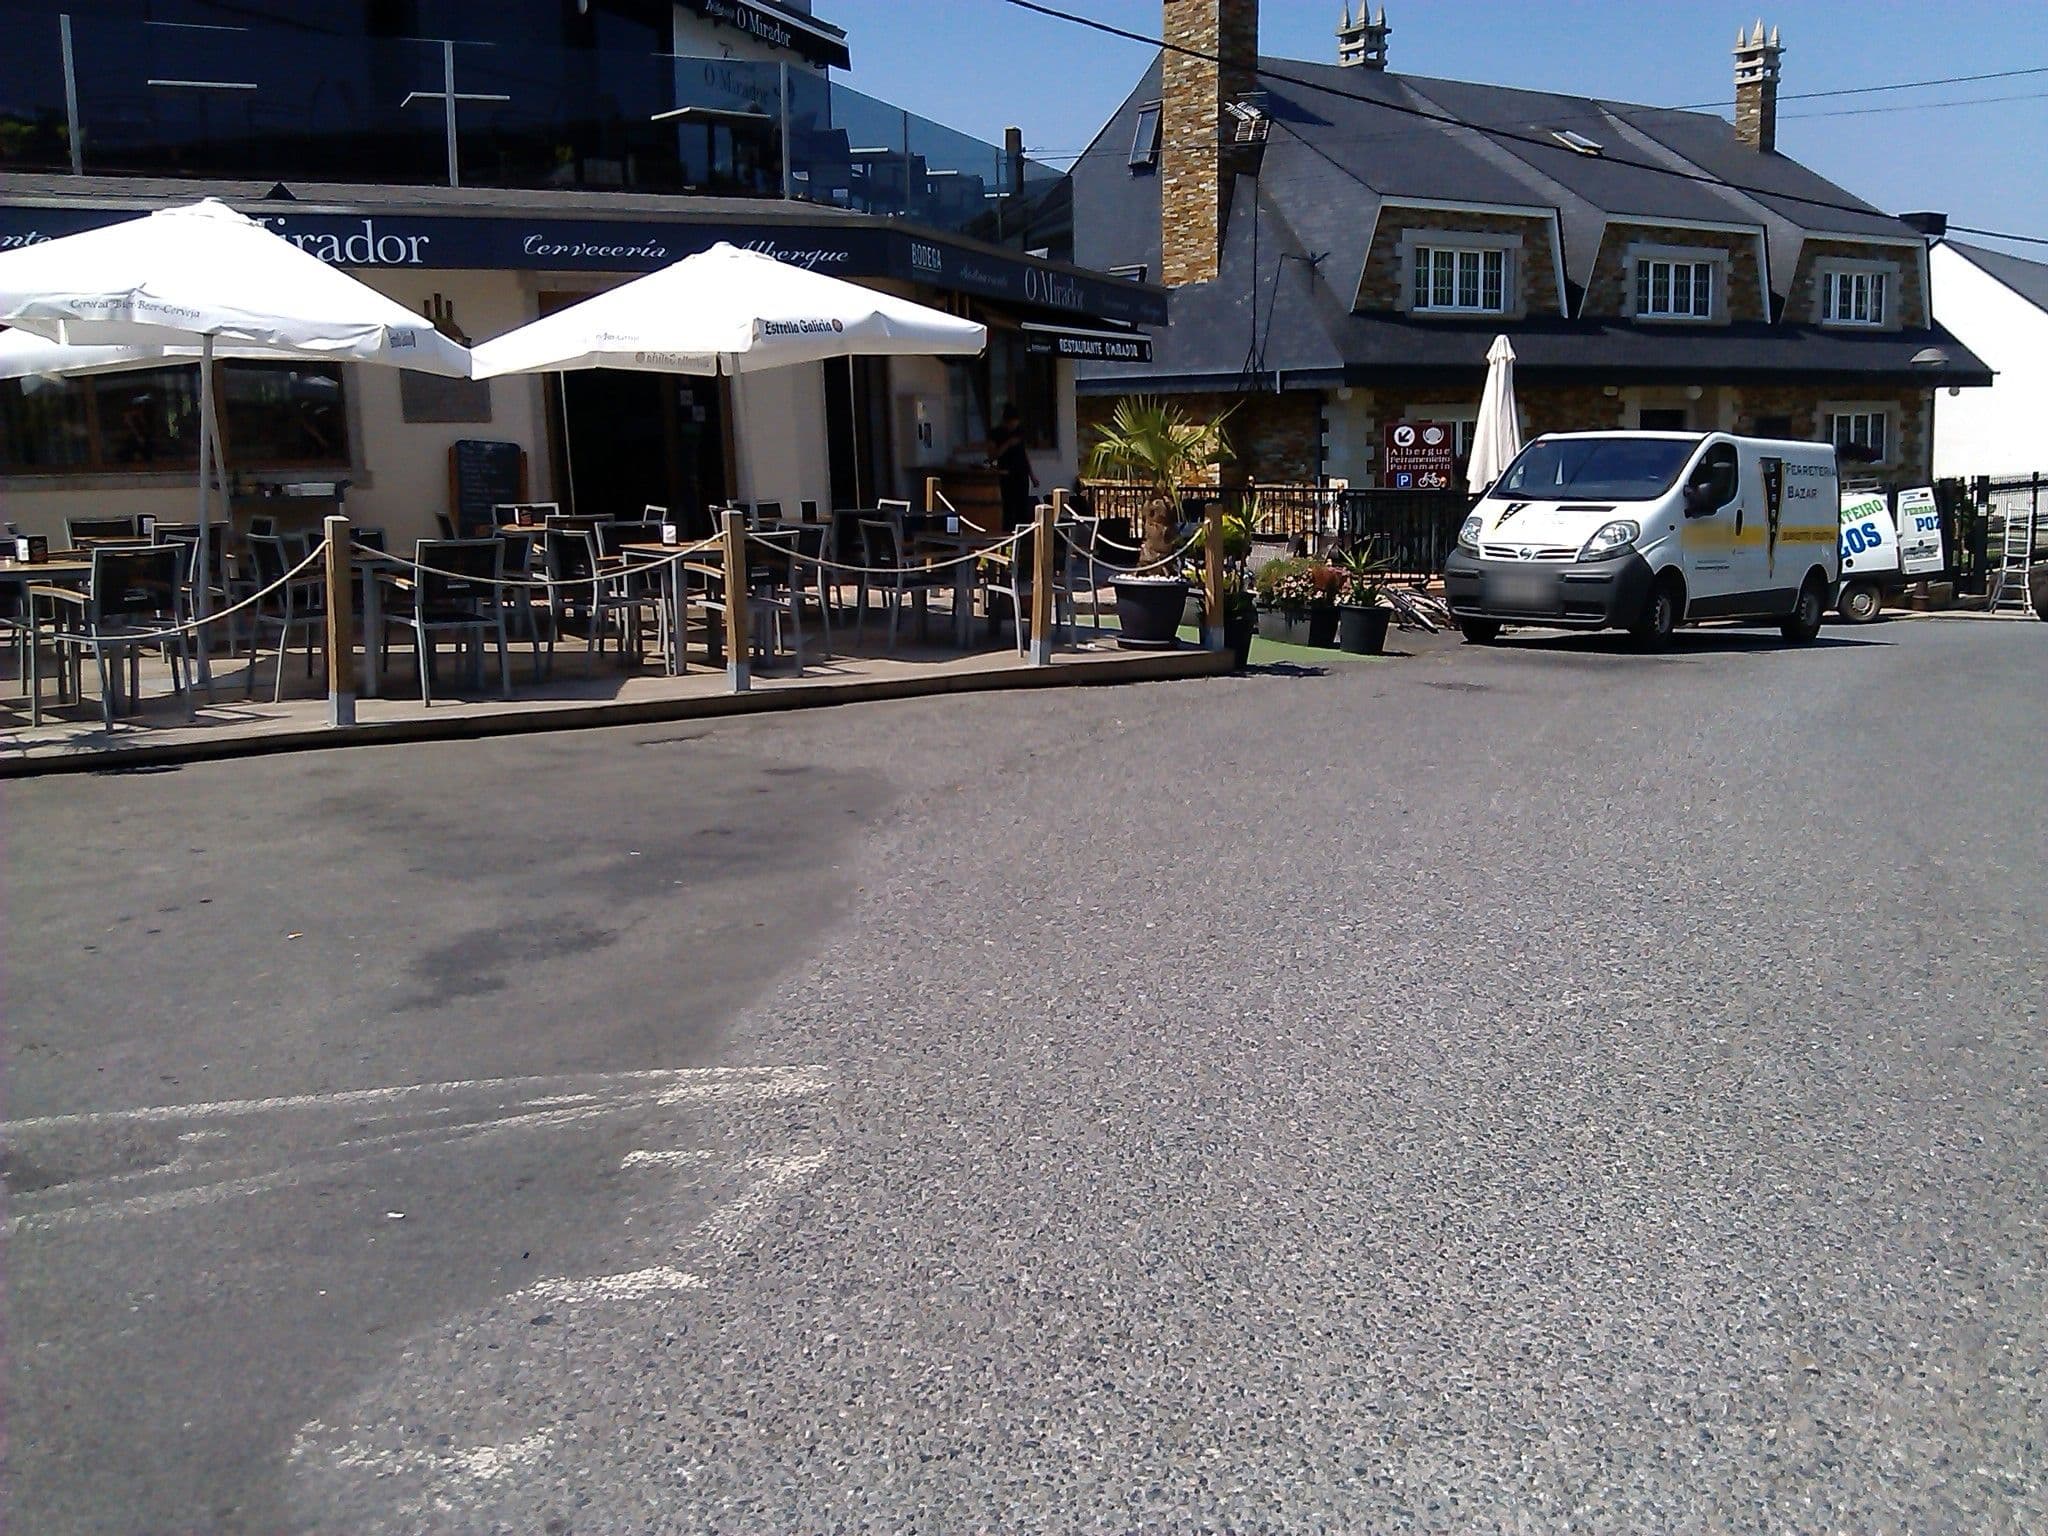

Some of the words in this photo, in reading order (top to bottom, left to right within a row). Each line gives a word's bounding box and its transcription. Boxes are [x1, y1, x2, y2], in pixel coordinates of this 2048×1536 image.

[748, 10, 792, 48] Mirador
[523, 233, 671, 260] Cervecería
[911, 242, 942, 268] BODEGA
[765, 320, 799, 336] Estrella
[800, 318, 832, 334] Galicia
[1059, 338, 1103, 356] RESTAURANTE
[1391, 448, 1451, 456] Albergue
[1400, 475, 1409, 486] P
